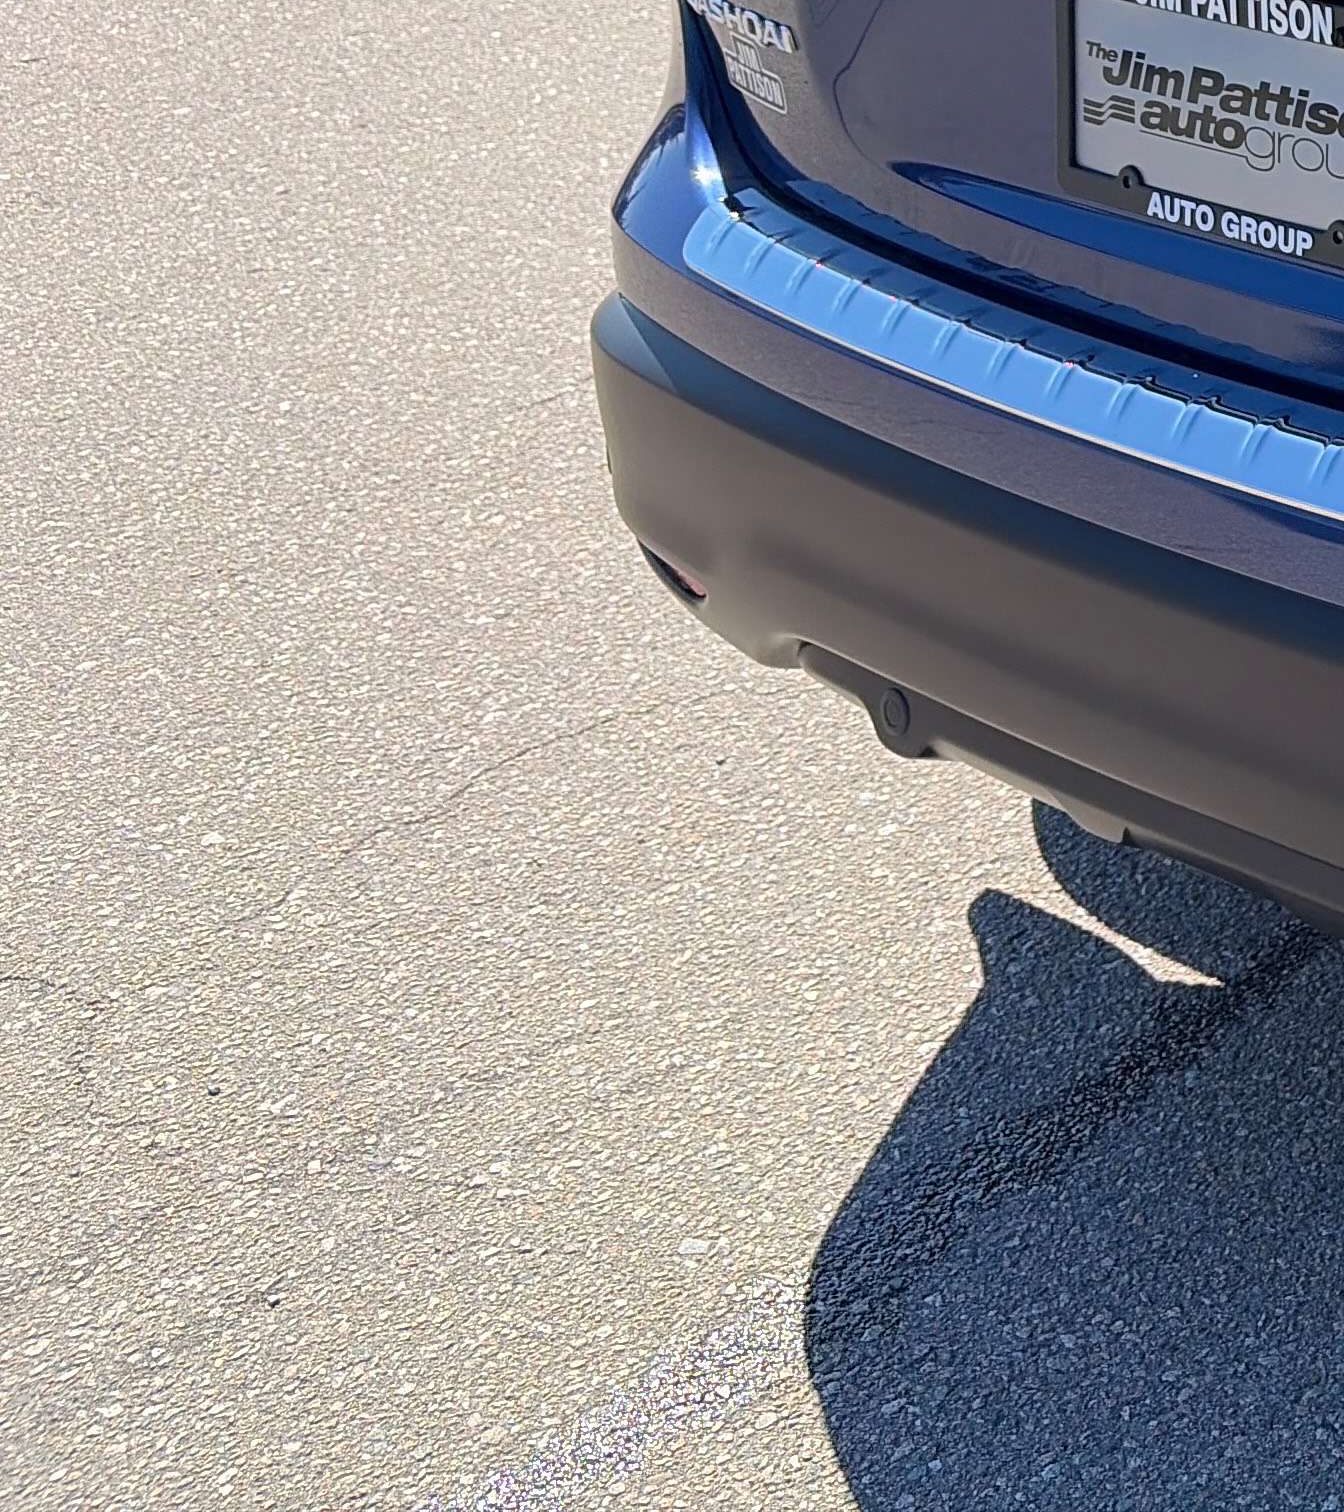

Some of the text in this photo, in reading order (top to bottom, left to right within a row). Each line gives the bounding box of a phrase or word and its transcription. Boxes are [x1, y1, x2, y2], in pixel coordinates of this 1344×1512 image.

[735, 37, 762, 72] JIM
[1086, 40, 1119, 63] The
[727, 55, 783, 108] PATTISON
[1147, 191, 1313, 256] AUTO GROUP
